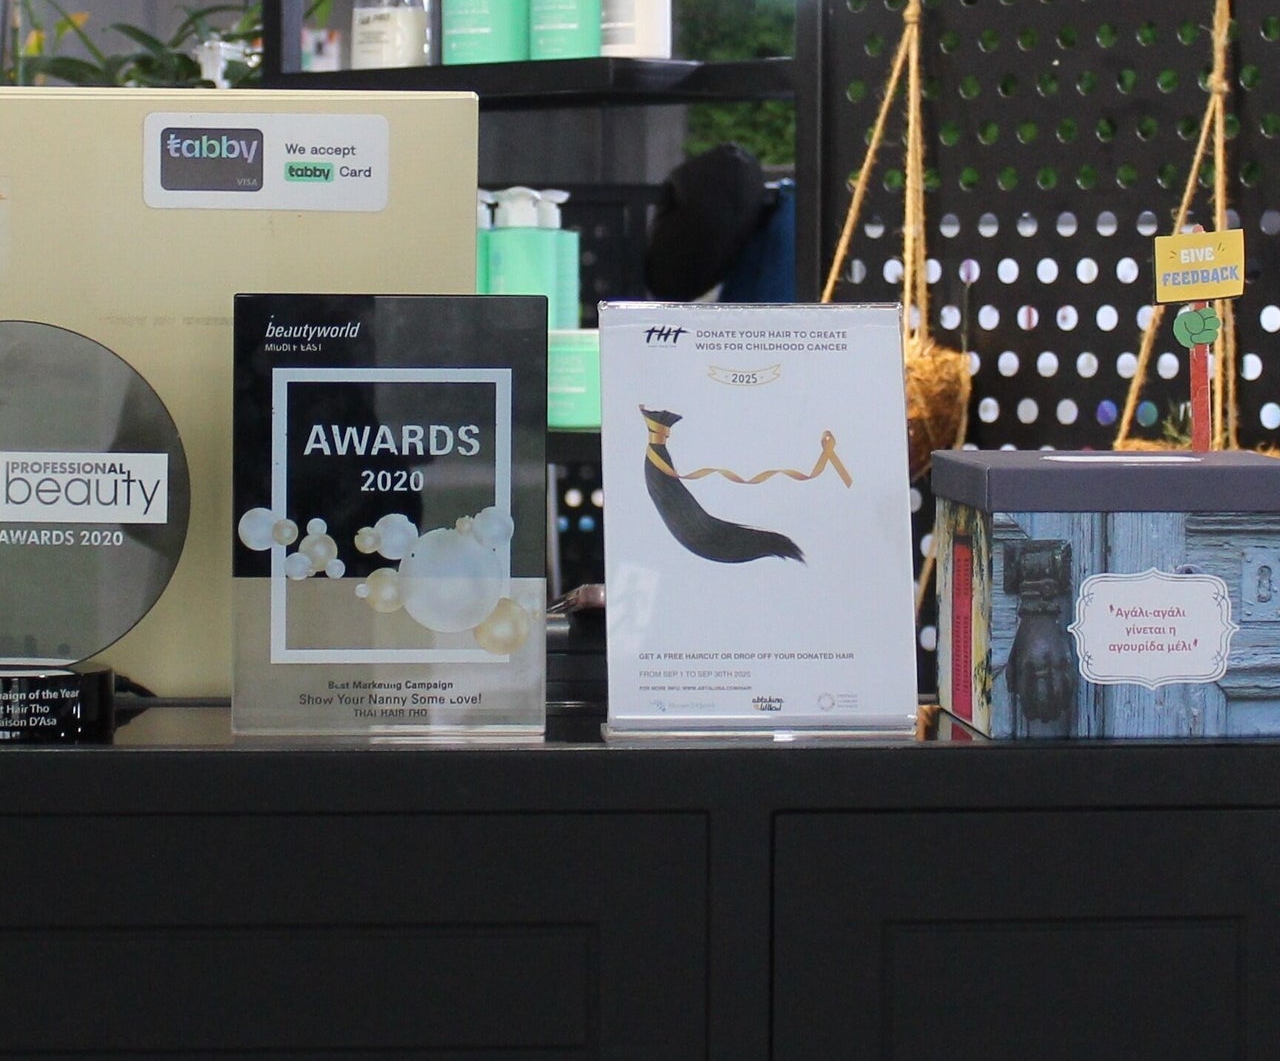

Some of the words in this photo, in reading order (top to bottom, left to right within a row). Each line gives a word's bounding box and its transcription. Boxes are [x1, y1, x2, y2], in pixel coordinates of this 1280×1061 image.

[167, 133, 259, 163] tabby
[285, 143, 306, 156] We
[310, 144, 356, 158] accept
[288, 165, 331, 180] tabby
[339, 166, 372, 179] Card
[236, 178, 259, 187] VISA
[1180, 247, 1215, 264] GIVE
[1162, 265, 1240, 286] FEEDBACK
[265, 321, 361, 342] beautyworld
[696, 329, 737, 339] DONATE
[738, 330, 767, 339] YOUR
[768, 330, 791, 339] HAIR
[792, 330, 807, 339] TO
[809, 330, 848, 339] CREATE
[695, 342, 722, 352] WIGS
[724, 342, 744, 352] FOR
[745, 342, 805, 352] CHILDHOOD
[807, 342, 848, 352] CANCER
[731, 373, 759, 385] 2025
[303, 424, 481, 457] AWARDS
[11, 461, 126, 475] PROFESSIONAL
[360, 469, 426, 492] 2020
[5, 461, 160, 515] beauty
[80, 530, 124, 546] 2020
[1125, 623, 1167, 637] γίνεται
[1169, 626, 1177, 637] η
[1108, 640, 1164, 654] αγουρίδα
[638, 652, 655, 661] GET
[656, 652, 663, 661] A
[663, 652, 684, 661] FREE
[685, 652, 719, 661] HAIRCUT
[720, 652, 733, 661] OR
[733, 652, 756, 661] DROP
[757, 652, 772, 661] OFF
[773, 652, 796, 661] YOUR
[797, 652, 834, 661] DONATED
[835, 652, 855, 661] HAIR
[639, 669, 662, 679] FROM
[664, 669, 678, 679] SEP
[685, 669, 696, 678] TO
[697, 669, 713, 679] SEP
[404, 680, 454, 692] Campaign
[29, 689, 40, 700] of
[42, 689, 58, 699] the
[60, 688, 80, 699] Year
[299, 693, 333, 706] Show
[337, 693, 364, 705] Your
[368, 694, 408, 707] Nanny
[411, 693, 446, 705] Some
[7, 703, 29, 714] Hair
[30, 703, 50, 714] Tho
